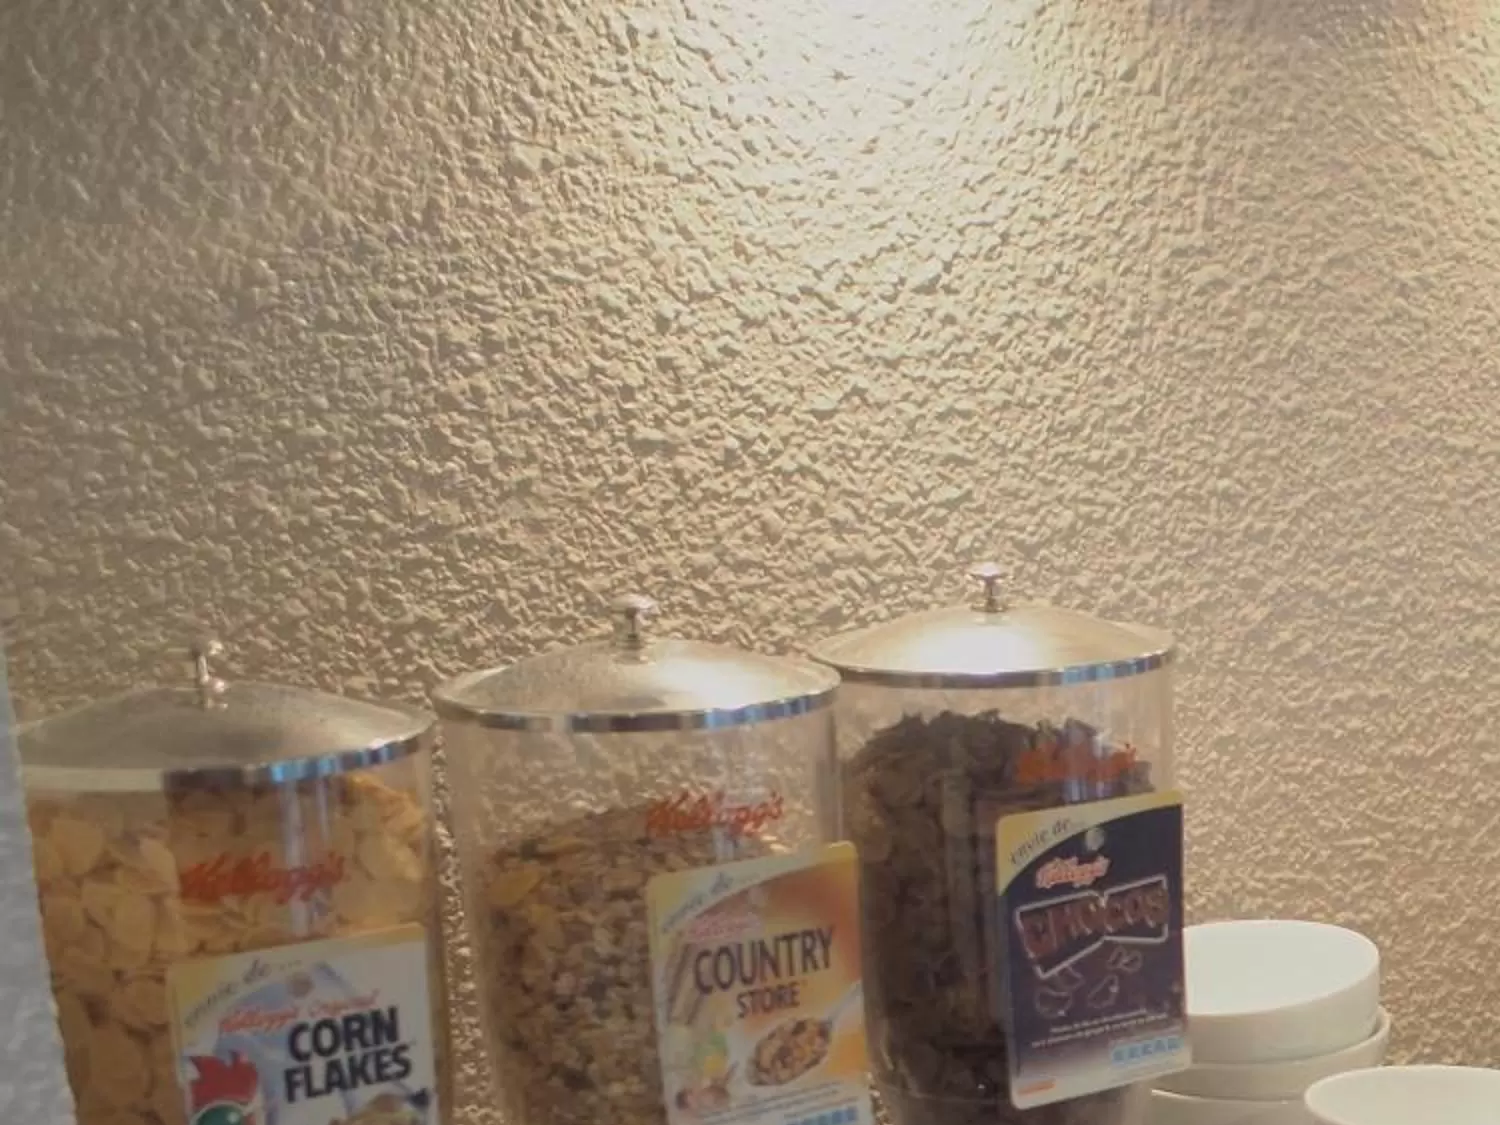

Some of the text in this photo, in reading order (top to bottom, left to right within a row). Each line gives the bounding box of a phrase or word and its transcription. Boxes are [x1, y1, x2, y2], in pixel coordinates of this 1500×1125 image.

[694, 927, 834, 994] COUNTRY
[737, 980, 802, 1018] STORE
[288, 1005, 399, 1062] CORN
[283, 1043, 412, 1104] FLAKES
